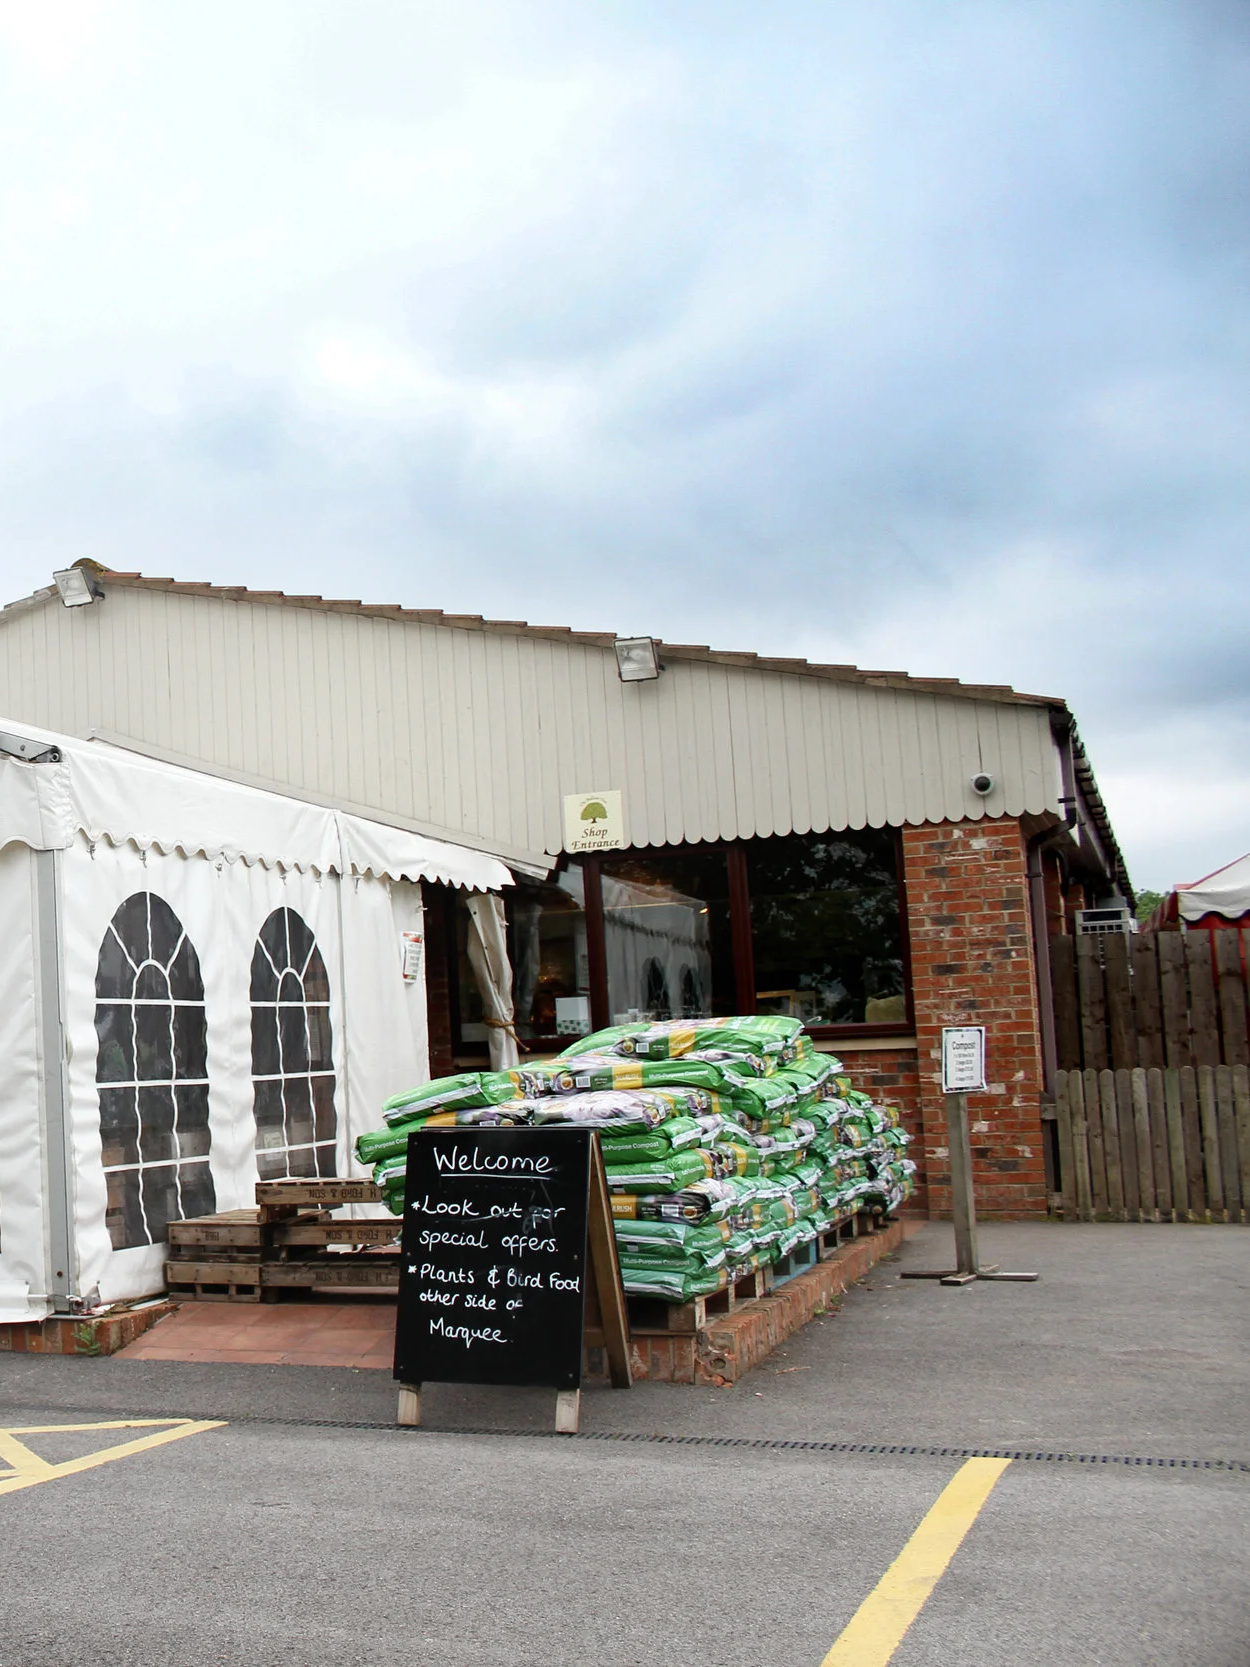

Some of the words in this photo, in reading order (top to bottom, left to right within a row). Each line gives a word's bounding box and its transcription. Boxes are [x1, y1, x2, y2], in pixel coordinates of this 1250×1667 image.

[581, 826, 608, 839] Shop
[571, 839, 620, 850] Entrance
[952, 1040, 976, 1051] Compost
[632, 1141, 659, 1149] Compost
[433, 1145, 554, 1173] Welcome
[490, 1202, 522, 1218] out
[419, 1229, 489, 1252] special
[507, 1267, 544, 1289] Bird
[549, 1272, 581, 1294] Food
[419, 1288, 460, 1306] other
[464, 1294, 497, 1310] side
[429, 1317, 508, 1349] Marquee
